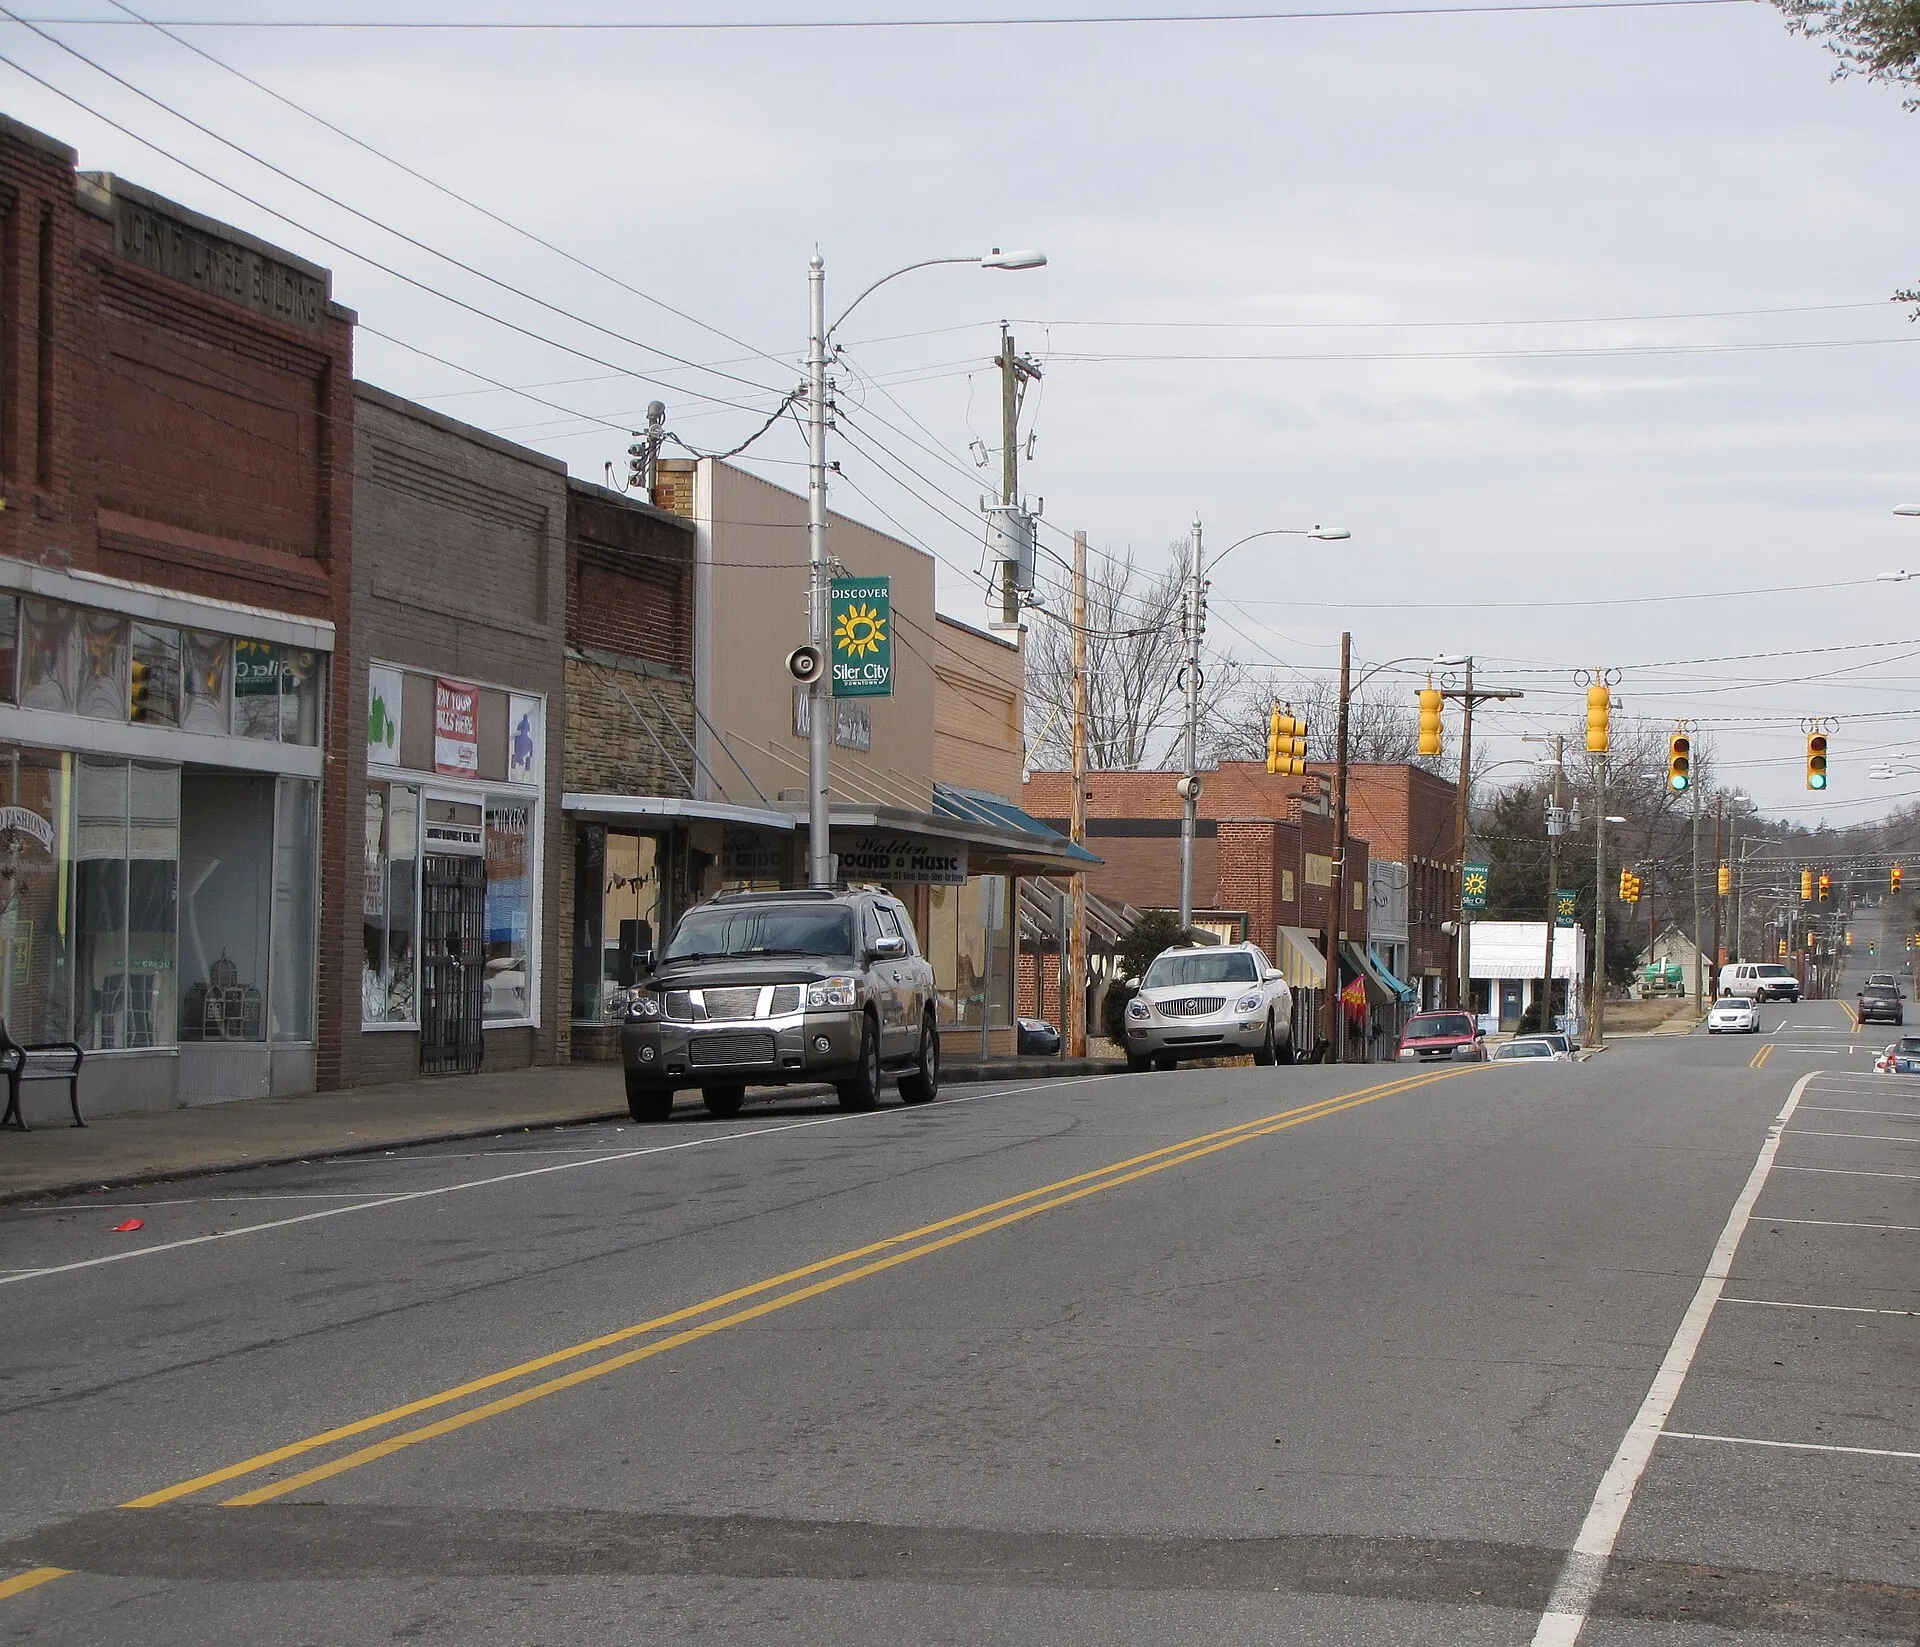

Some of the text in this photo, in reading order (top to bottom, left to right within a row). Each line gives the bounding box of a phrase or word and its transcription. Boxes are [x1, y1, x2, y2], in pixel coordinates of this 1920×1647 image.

[253, 261, 317, 324] BUILDING
[831, 588, 889, 599] DISCOVER
[833, 663, 889, 684] Siler City
[437, 687, 472, 712] PAY YOUR
[455, 714, 474, 735] HERE
[6, 809, 49, 840] FASHIONS
[911, 856, 958, 871] MUSIC
